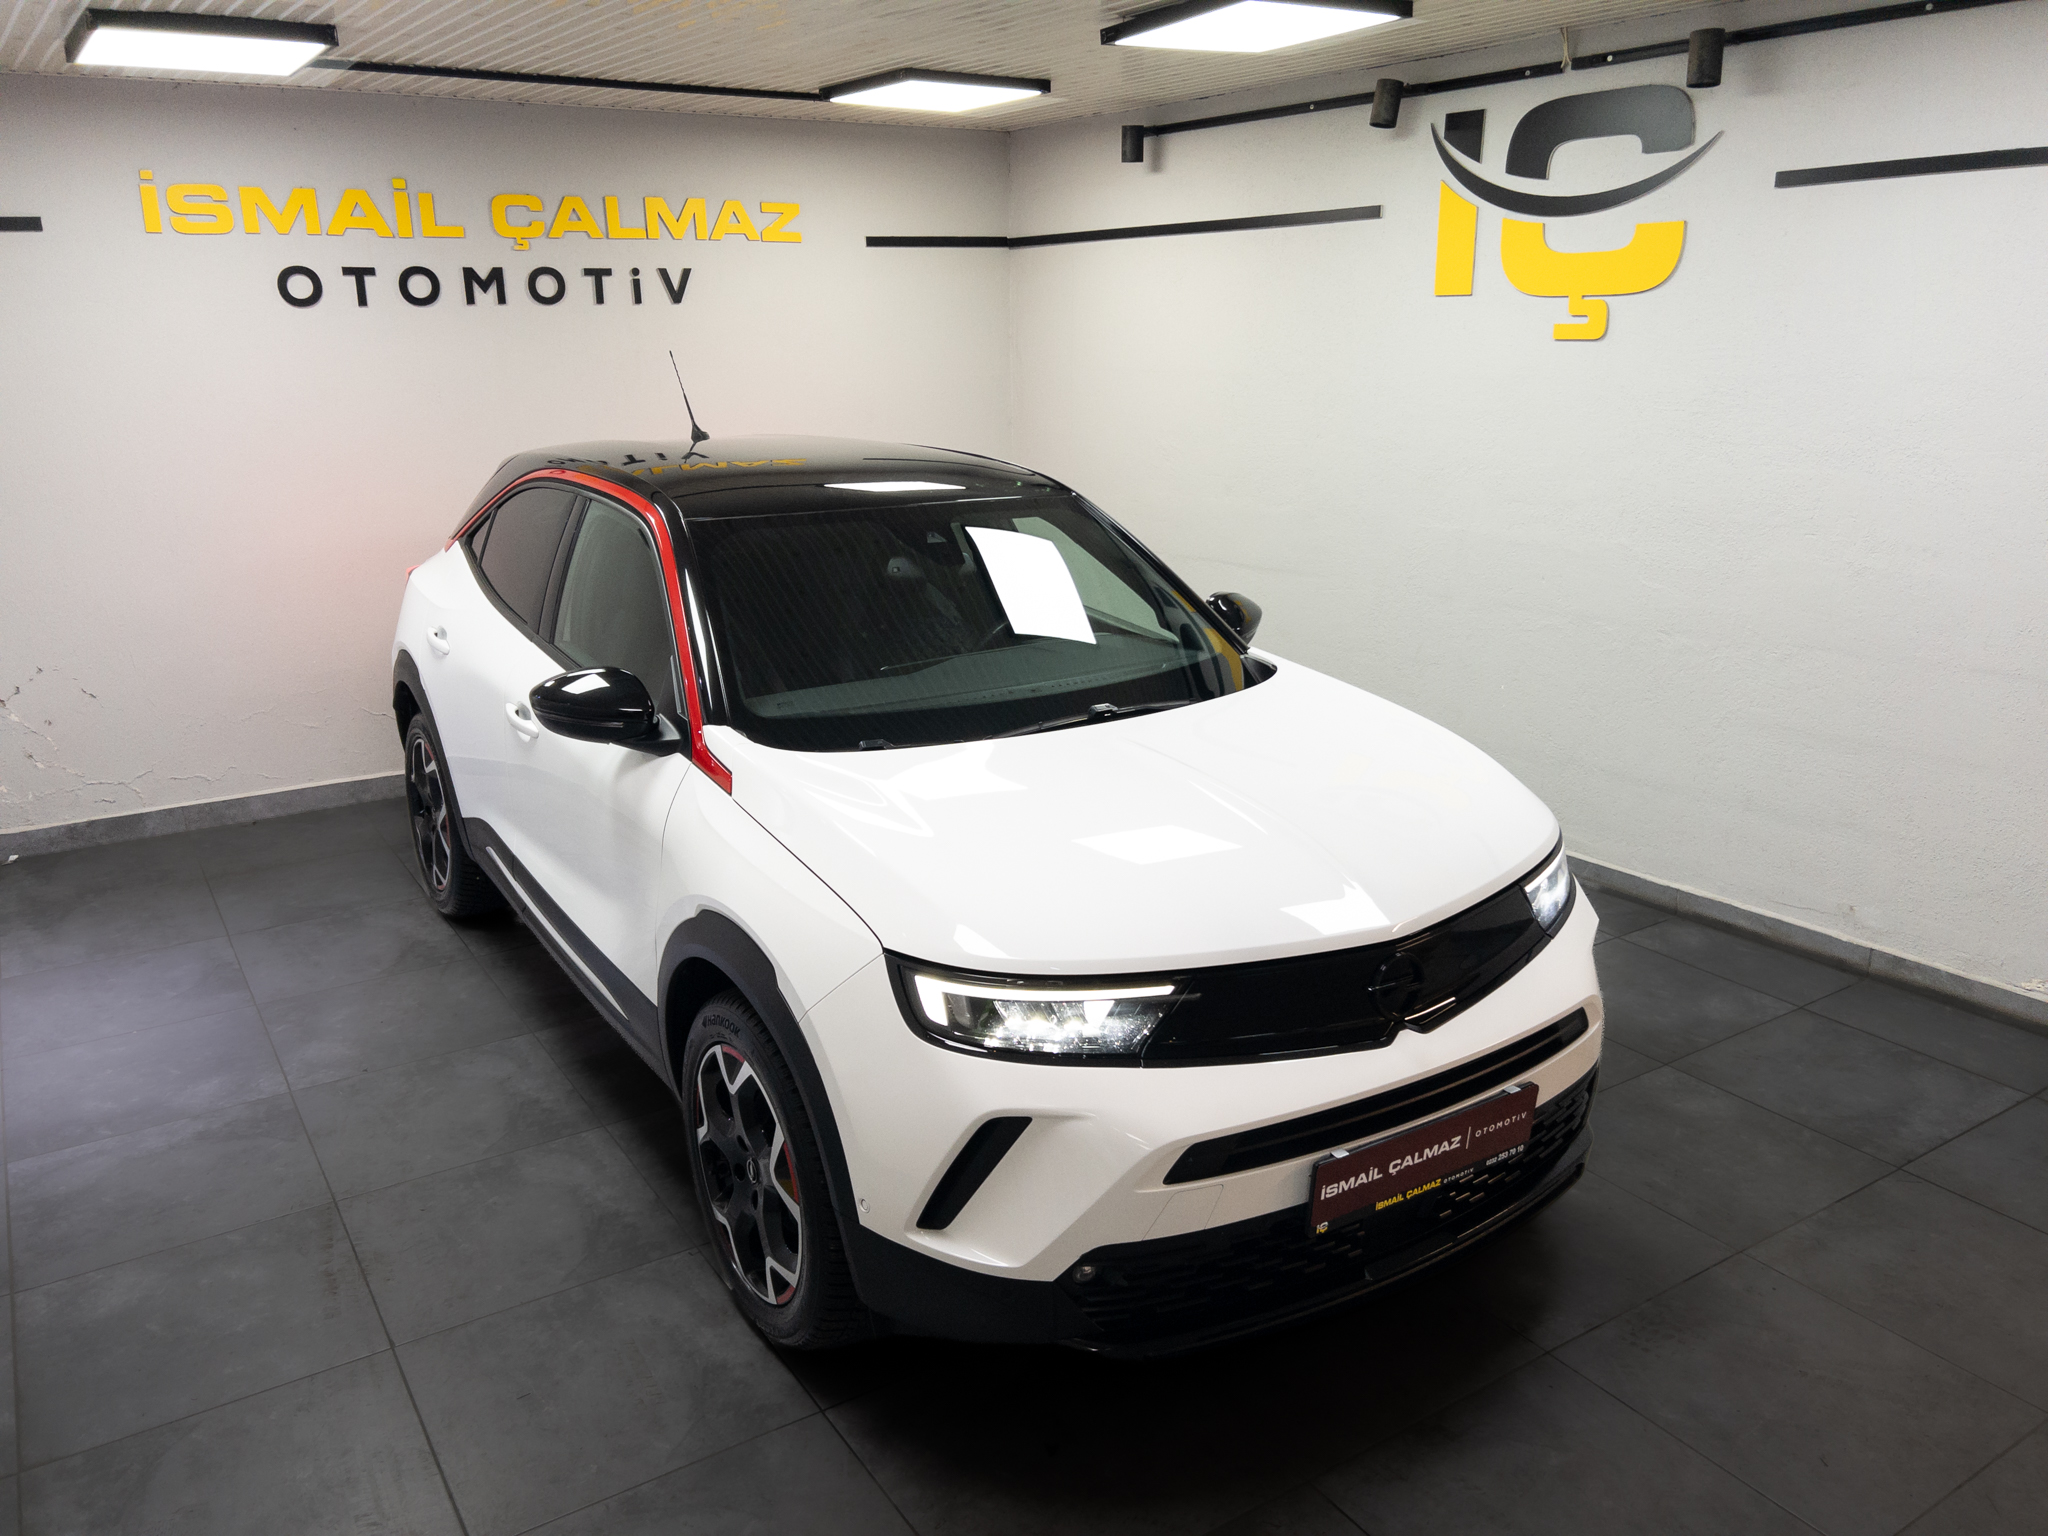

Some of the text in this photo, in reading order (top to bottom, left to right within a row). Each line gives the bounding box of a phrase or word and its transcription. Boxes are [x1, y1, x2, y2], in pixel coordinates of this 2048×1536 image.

[138, 169, 802, 251] İSMAİL ÇALMAZ
[1320, 1166, 1383, 1200] İSMAİL
[1388, 1135, 1462, 1176] ÇALMAZ
[1406, 1178, 1442, 1200] ÇALMAZ
